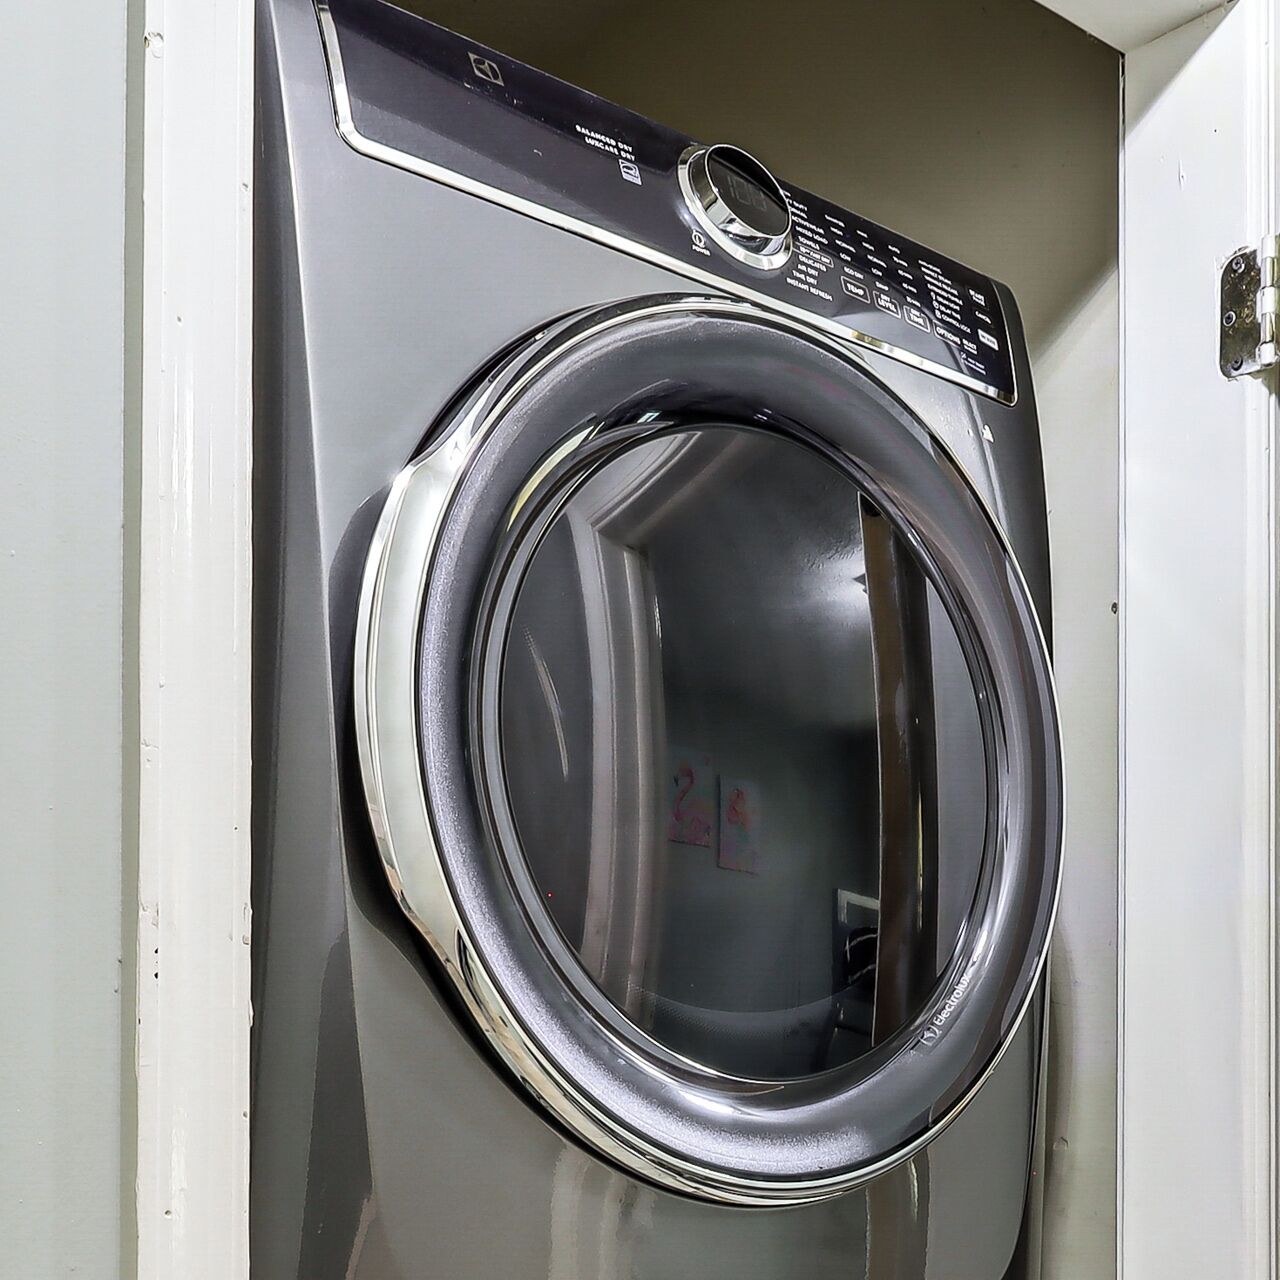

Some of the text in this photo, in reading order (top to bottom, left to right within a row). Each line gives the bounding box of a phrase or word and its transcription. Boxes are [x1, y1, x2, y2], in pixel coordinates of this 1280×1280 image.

[575, 123, 633, 152] BALANCED DRY
[585, 136, 635, 161] LUXCARE DRY
[798, 254, 827, 272] DELICATES
[805, 275, 818, 286] DRY
[846, 282, 866, 297] TEMP
[936, 325, 962, 345] OPTIONS
[932, 973, 971, 1026] Electrolux
